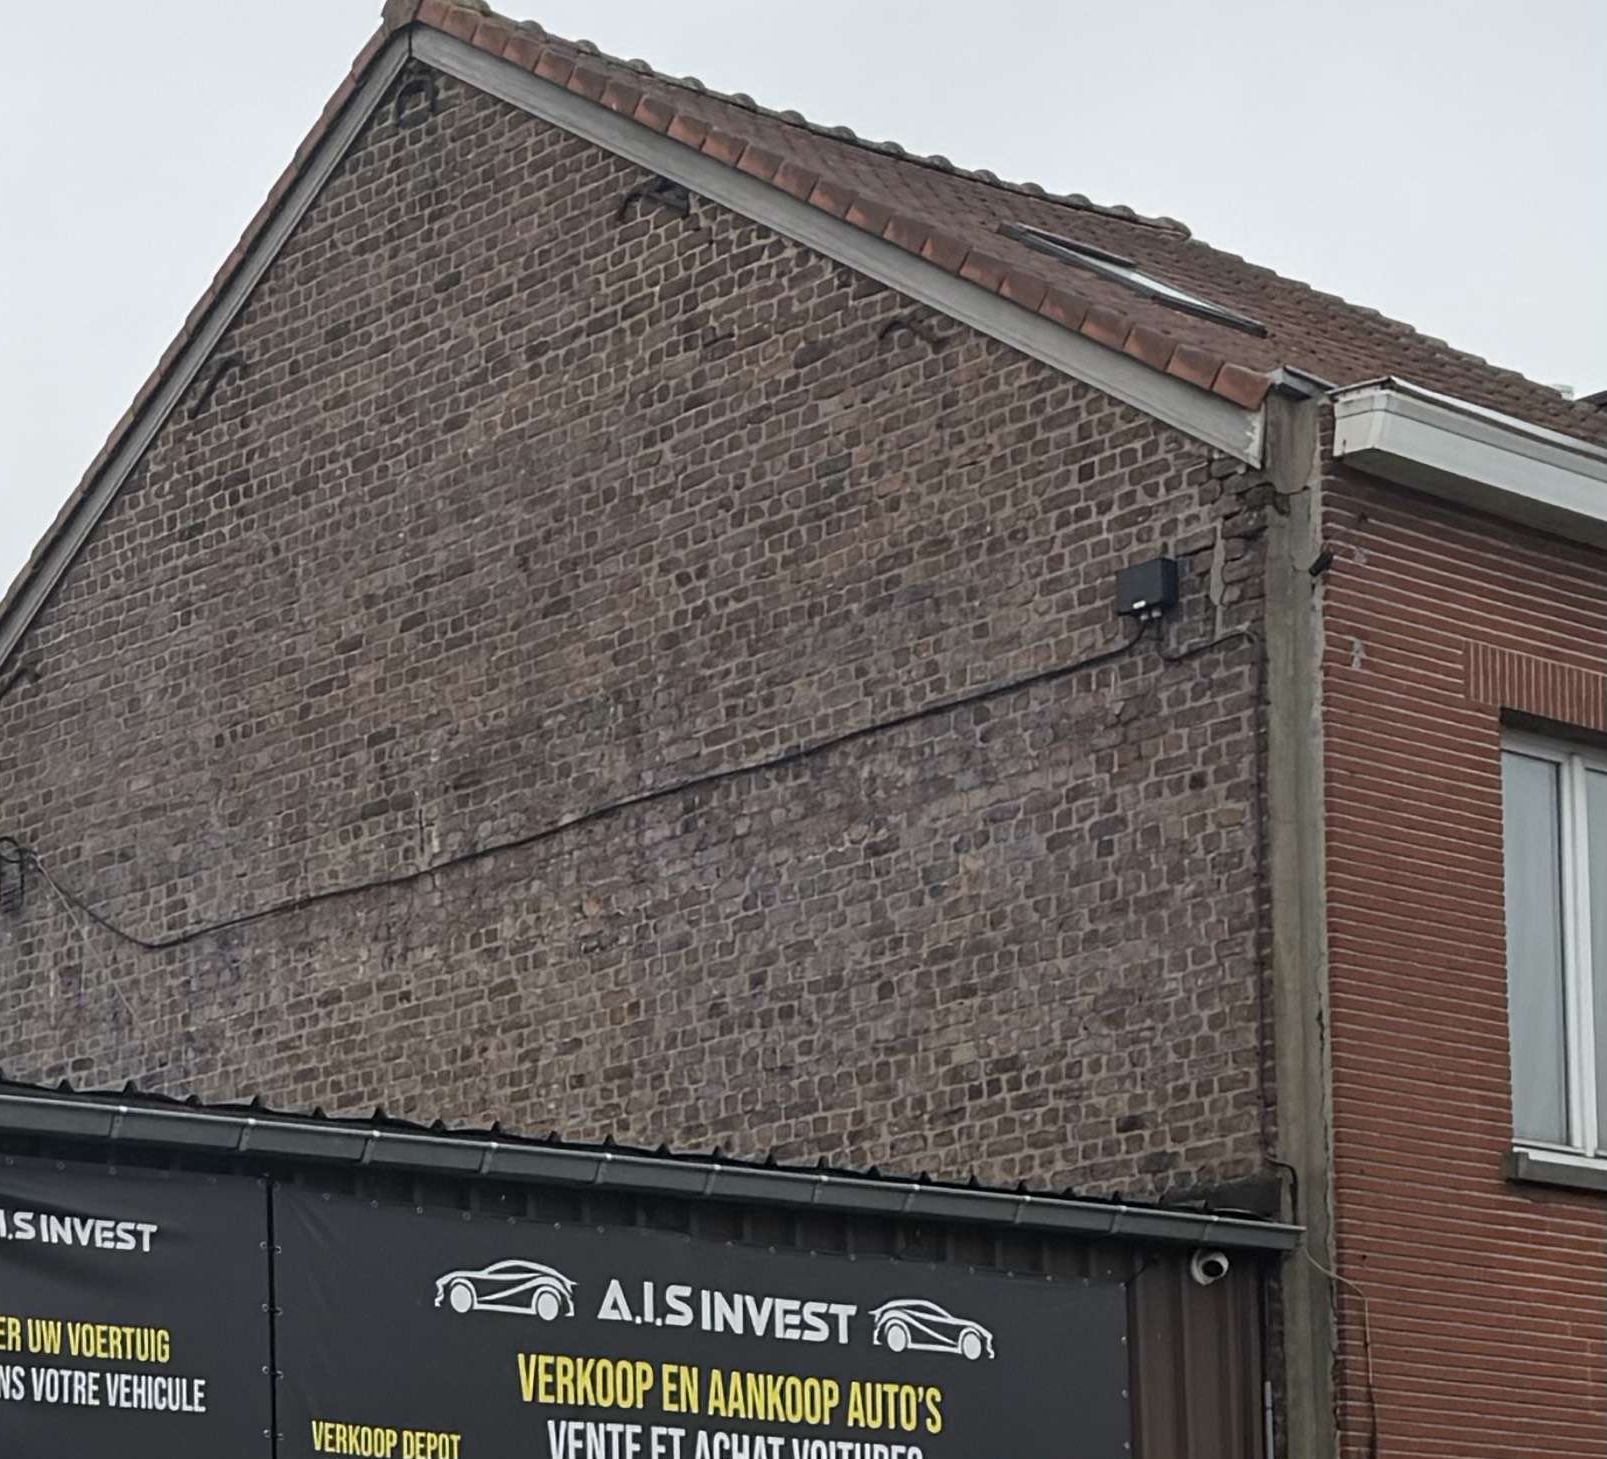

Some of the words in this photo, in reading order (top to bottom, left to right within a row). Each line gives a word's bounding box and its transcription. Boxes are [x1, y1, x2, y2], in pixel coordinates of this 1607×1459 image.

[41, 1215, 158, 1252] INVEST
[597, 1279, 694, 1326] A.I.S
[701, 1289, 857, 1344] INVEST
[27, 1319, 63, 1355] UW
[67, 1322, 170, 1363] VOERTUIG
[31, 1367, 100, 1407] VOTRE
[105, 1372, 206, 1413] VEHICULE
[517, 1353, 654, 1409] VERKOOP
[662, 1364, 699, 1414] EN
[707, 1368, 840, 1426] AANKOOP
[312, 1420, 398, 1459] VERKOOP
